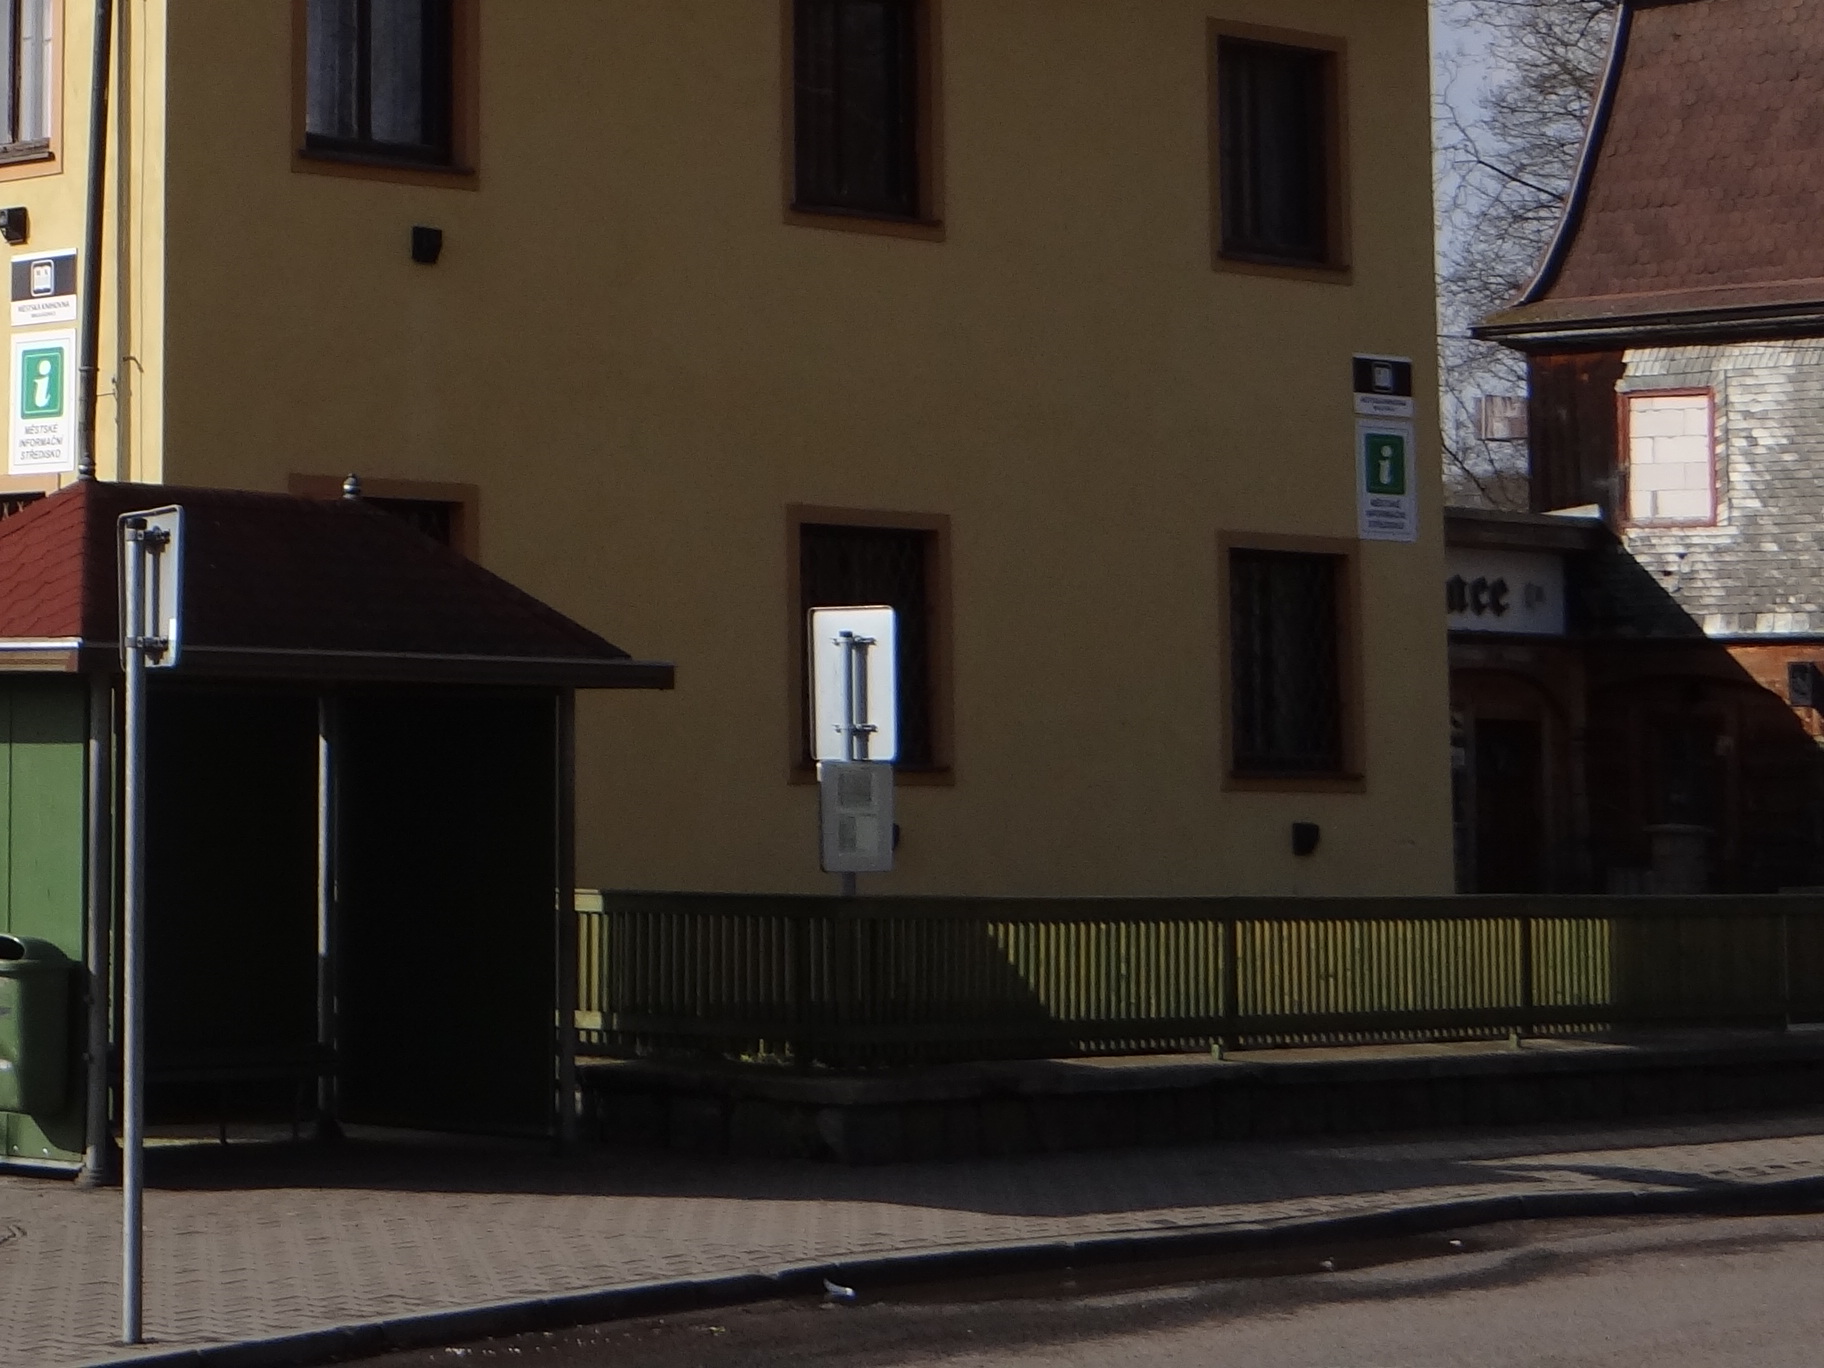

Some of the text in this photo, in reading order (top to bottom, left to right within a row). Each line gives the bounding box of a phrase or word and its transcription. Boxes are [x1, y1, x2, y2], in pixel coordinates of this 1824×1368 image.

[24, 422, 59, 435] MĚSTSKÉ
[19, 435, 64, 447] INFORMAČNÍ
[20, 448, 61, 460] STŘEDISKO
